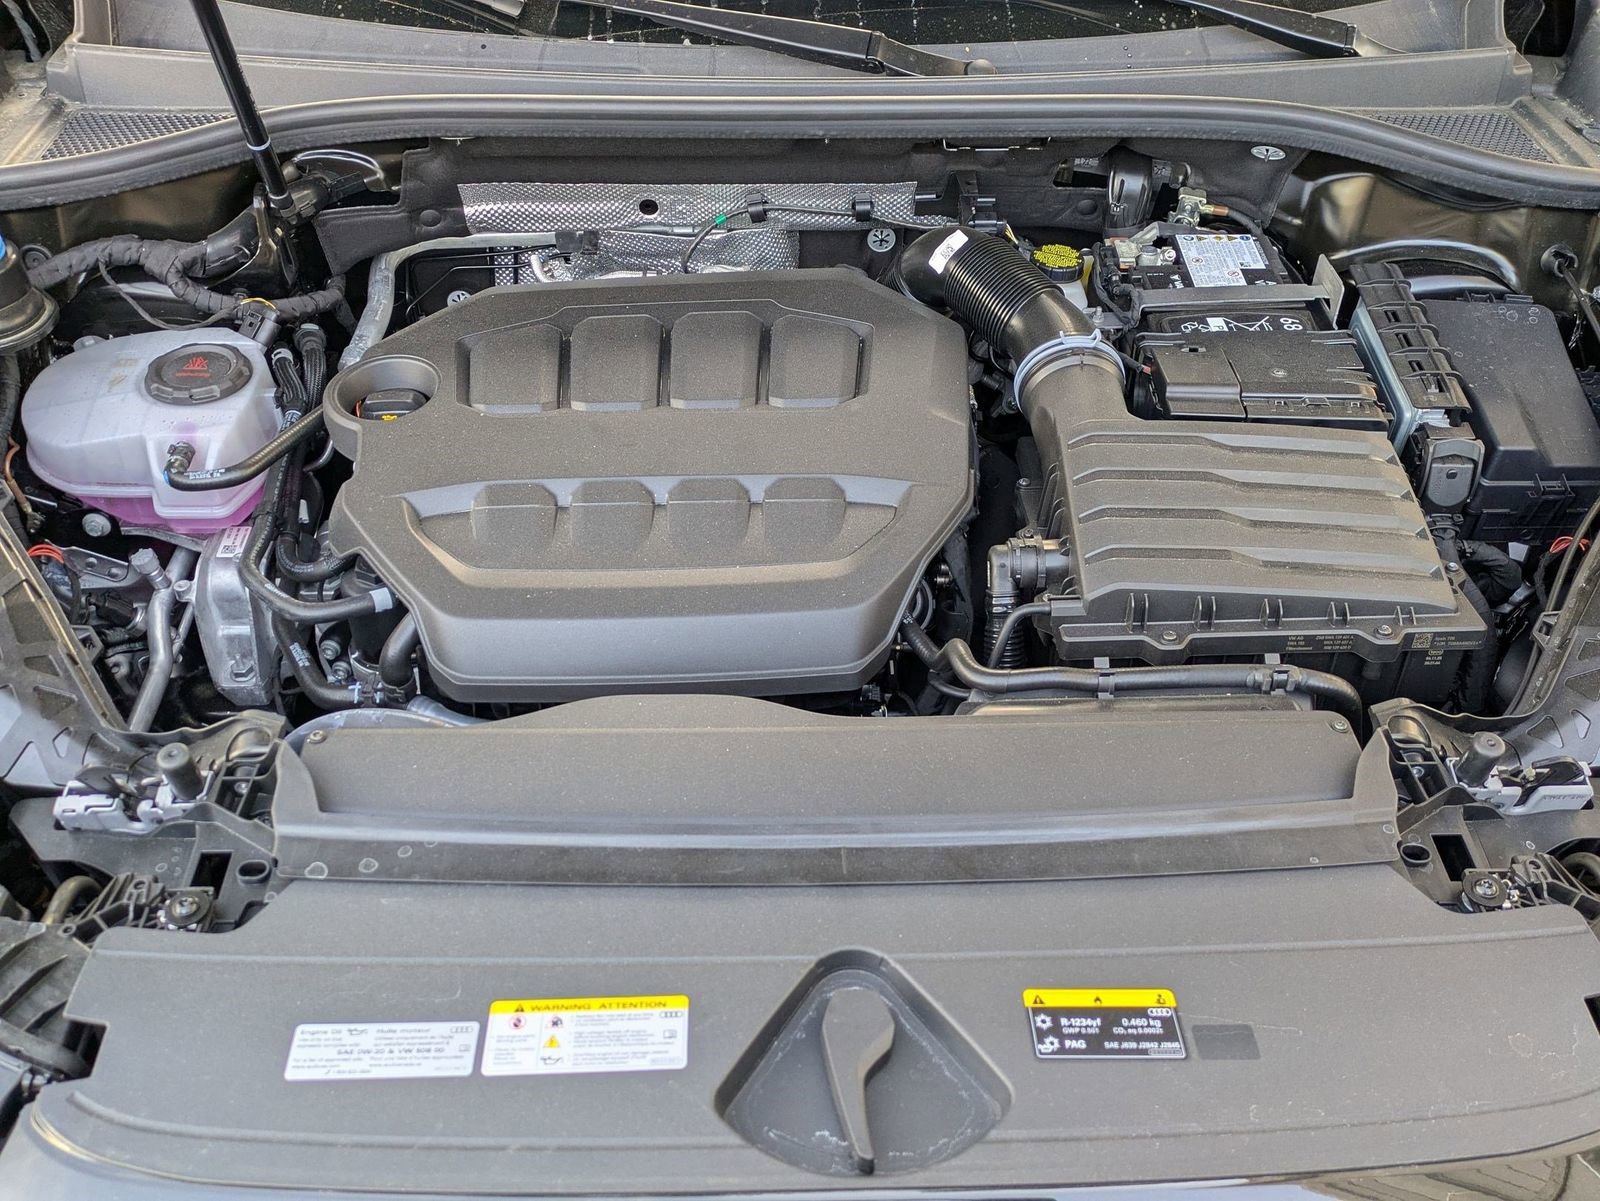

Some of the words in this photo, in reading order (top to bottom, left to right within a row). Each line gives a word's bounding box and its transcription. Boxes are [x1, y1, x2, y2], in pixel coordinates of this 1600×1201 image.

[530, 1003, 592, 1012] WARNING
[598, 1001, 667, 1010] ATTENTION
[1060, 1017, 1101, 1028] R-1234yf
[1121, 1017, 1148, 1027] 0.460
[1149, 1017, 1162, 1028] kg
[1064, 1039, 1087, 1050] PAG
[1104, 1041, 1120, 1049] SAE
